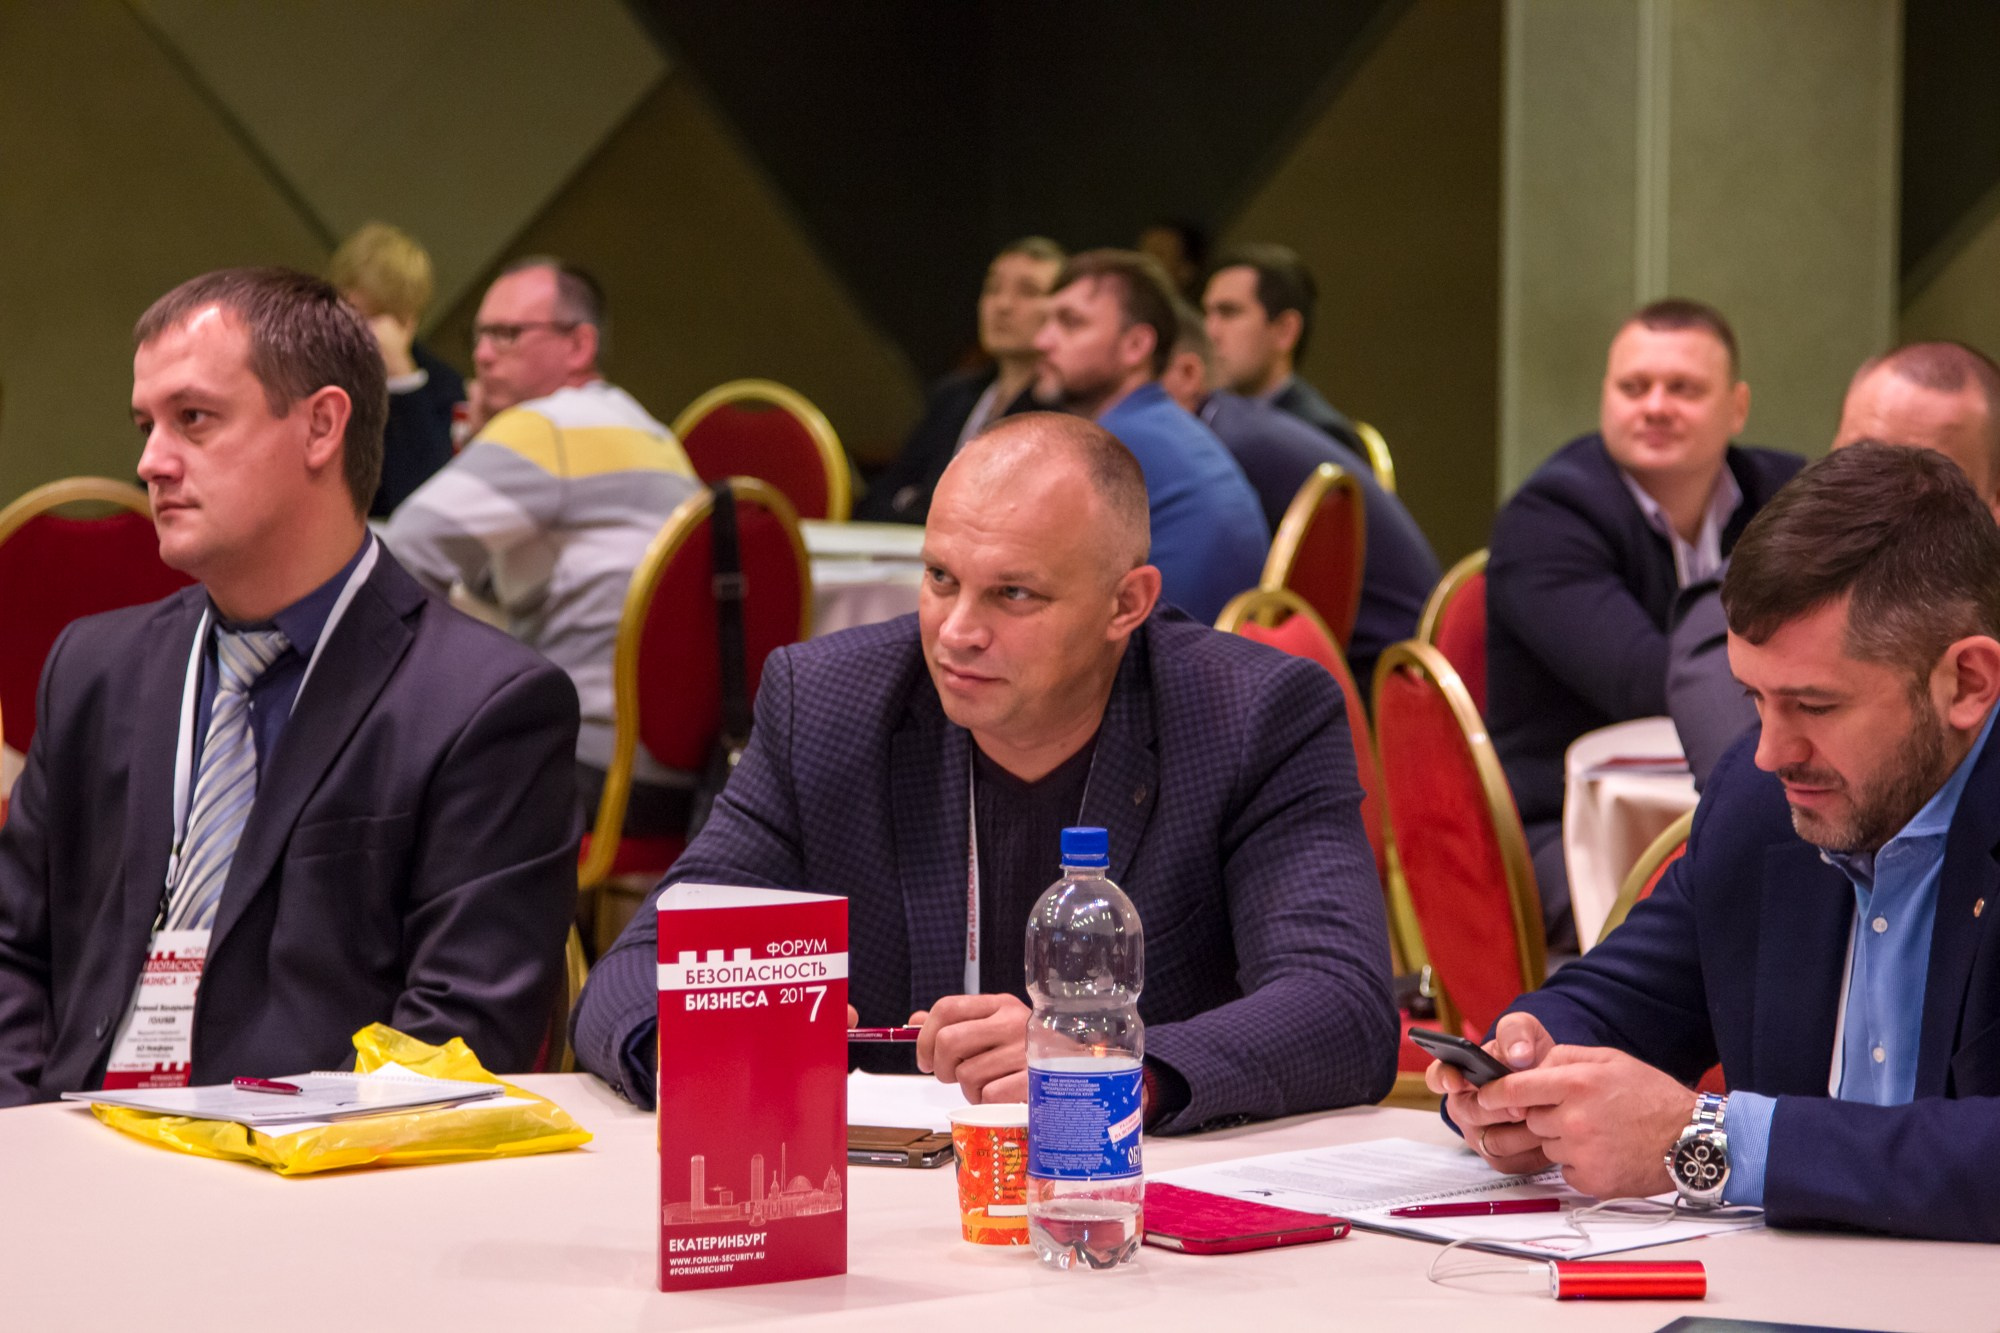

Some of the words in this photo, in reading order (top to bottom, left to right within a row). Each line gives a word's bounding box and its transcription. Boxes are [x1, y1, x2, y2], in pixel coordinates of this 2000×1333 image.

[766, 938, 828, 957] ФОРУМ
[685, 961, 828, 985] БЕЗОПАСНОСТЬ
[685, 990, 769, 1011] БИЗНЕСА
[779, 985, 828, 1022] 2017
[669, 1232, 767, 1252] ЕКАТЕРИНБУРГ
[670, 1252, 765, 1266] WWW.FORUM-SECURITY.RU
[670, 1264, 734, 1276] #FORUMSECURITY
